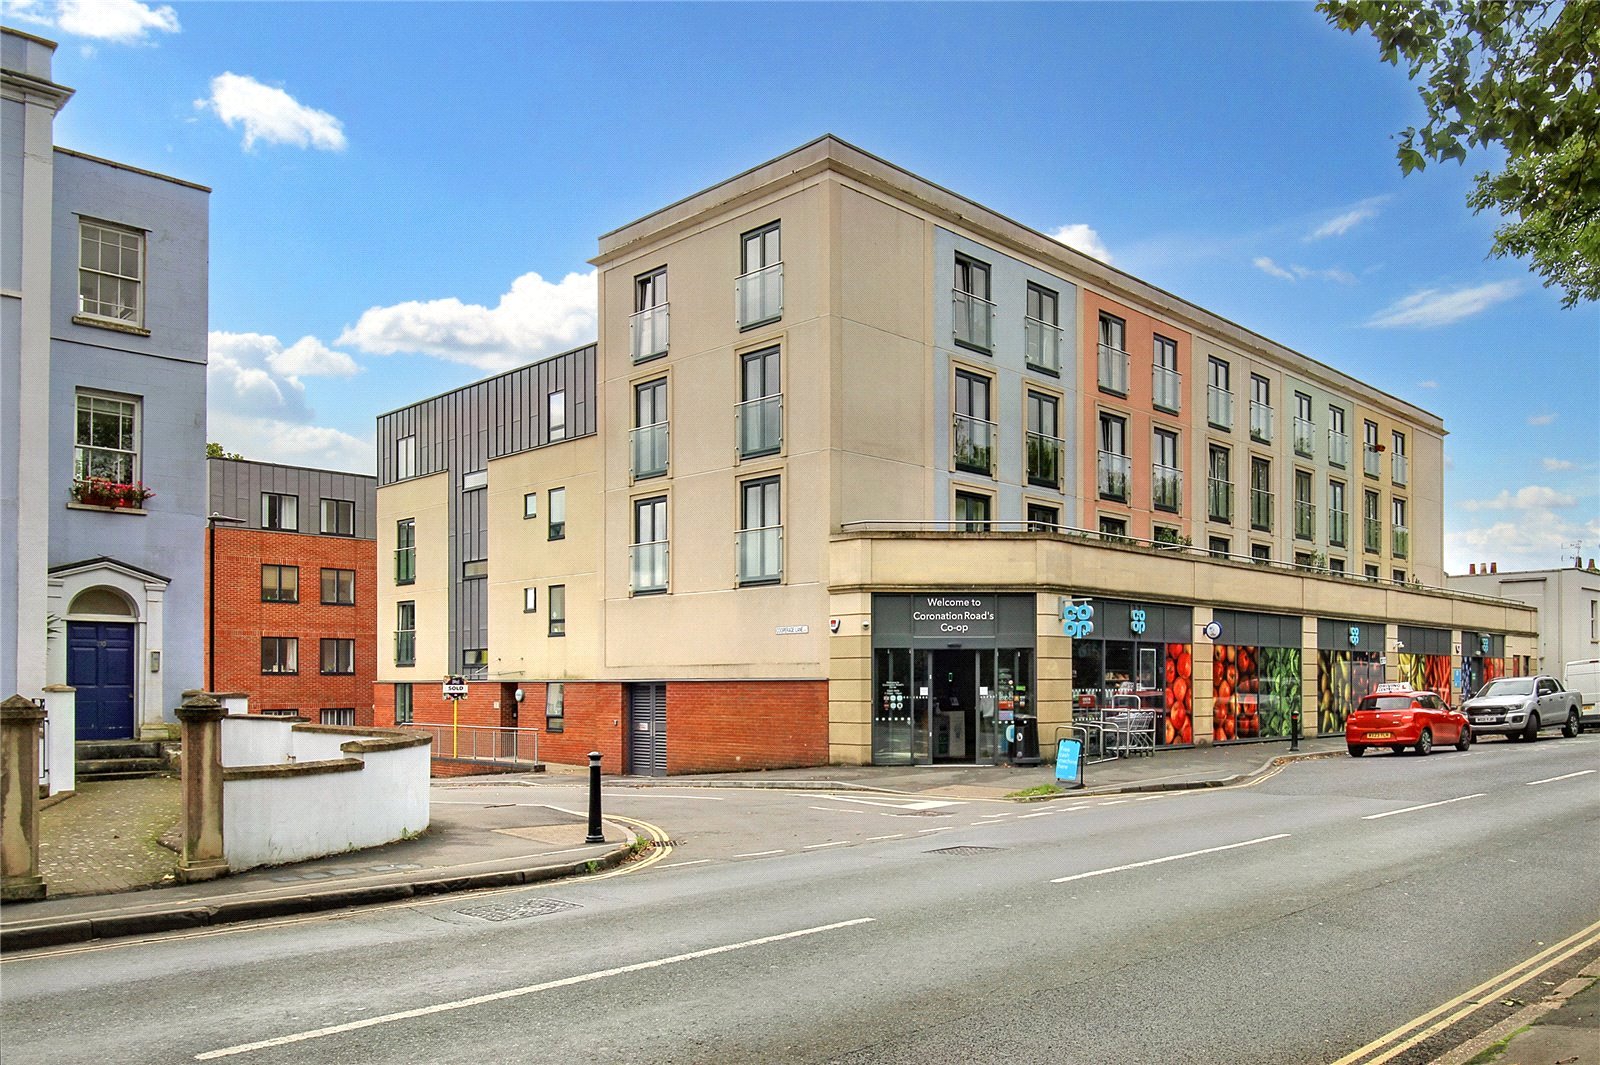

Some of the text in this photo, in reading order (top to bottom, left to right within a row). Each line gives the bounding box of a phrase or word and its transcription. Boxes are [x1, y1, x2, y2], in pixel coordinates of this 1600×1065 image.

[927, 597, 982, 607] Welcome to
[913, 611, 995, 621] Coronation Road's
[940, 623, 969, 633] Co-op
